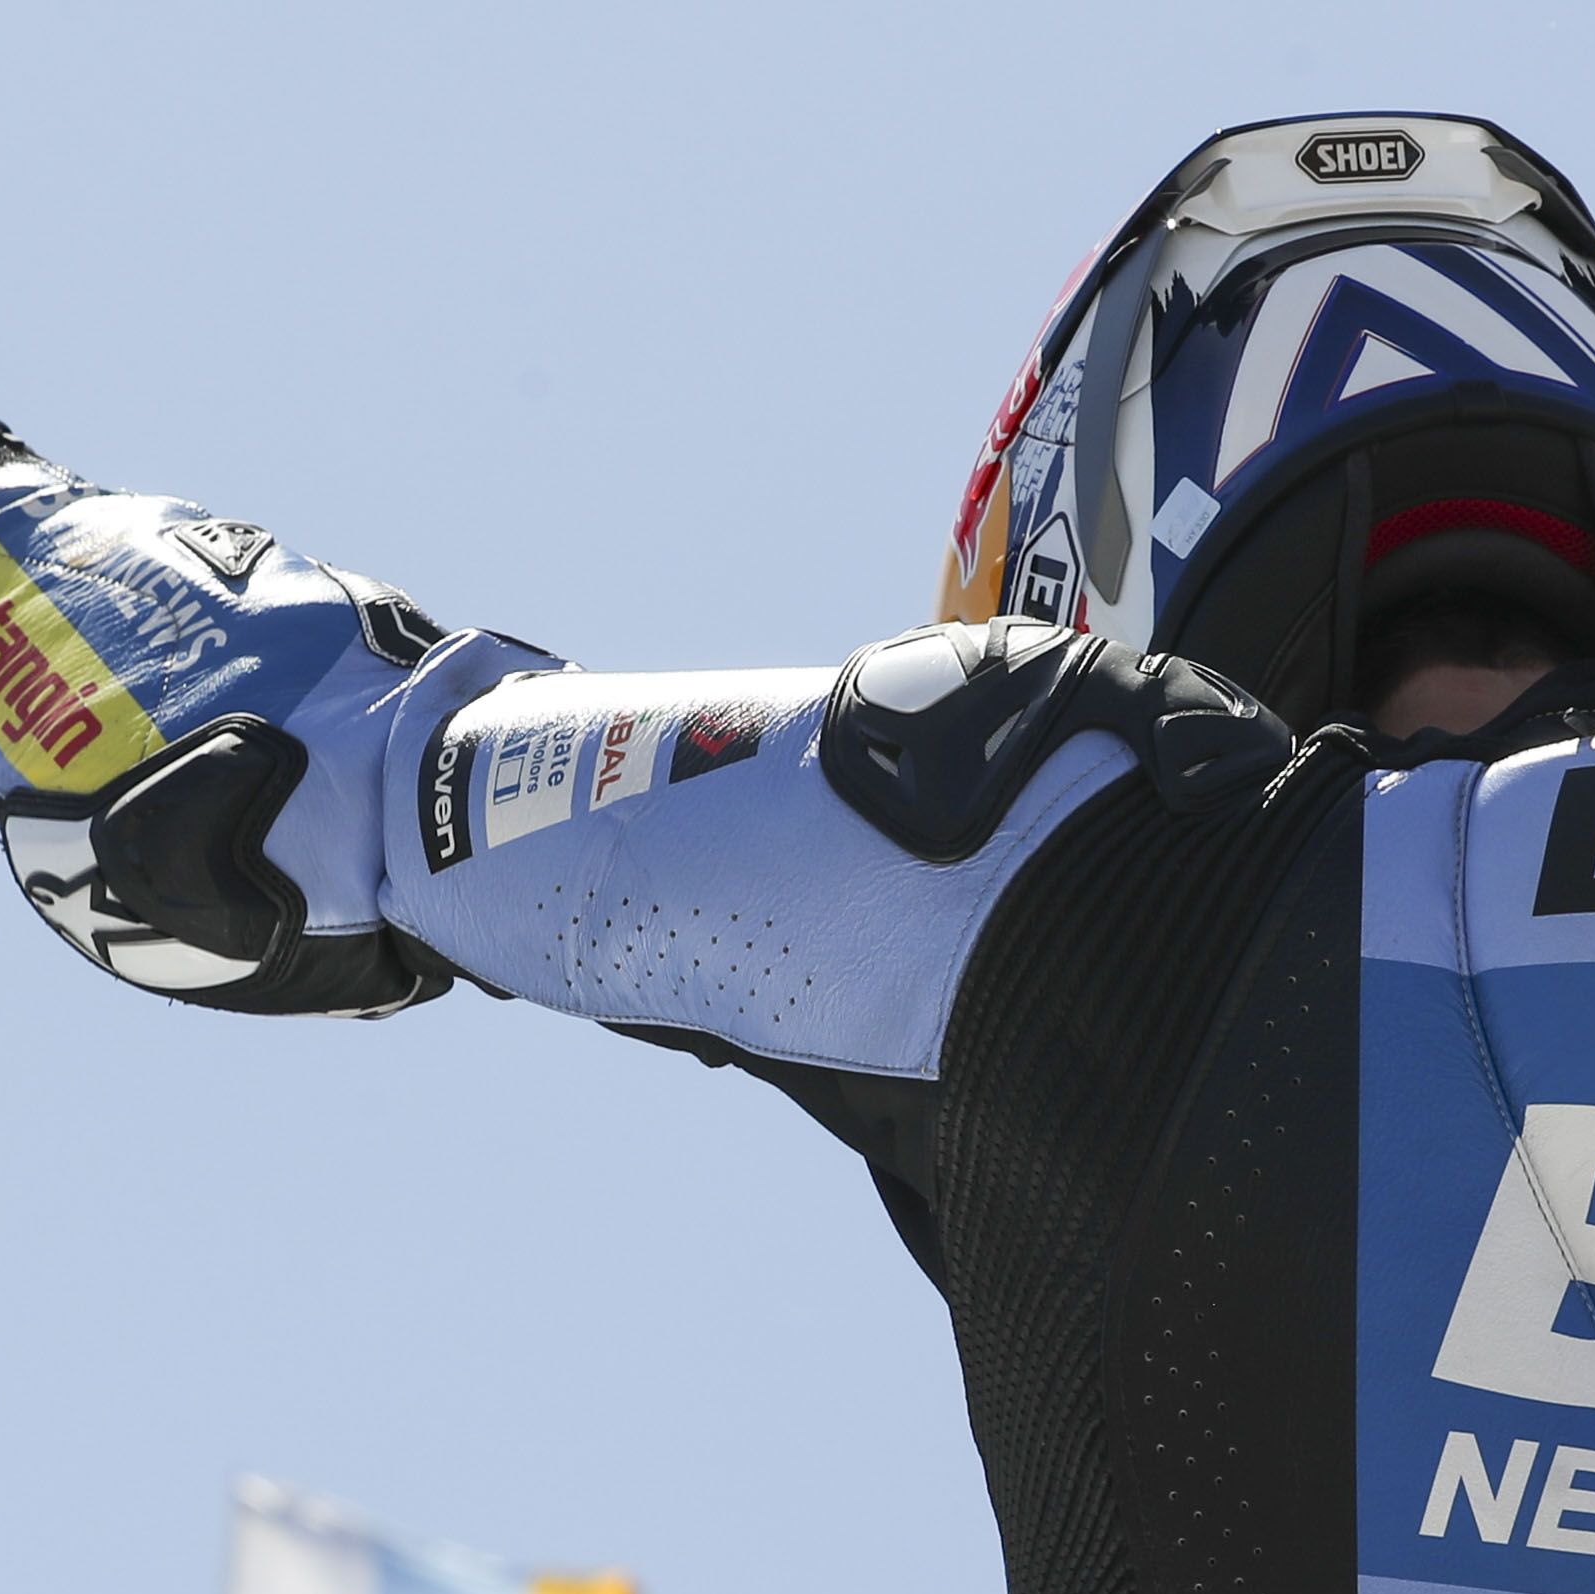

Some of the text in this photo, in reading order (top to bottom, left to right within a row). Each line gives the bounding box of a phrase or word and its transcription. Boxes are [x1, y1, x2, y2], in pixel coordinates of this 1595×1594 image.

[1316, 140, 1407, 173] SHOEI
[595, 714, 633, 802] BAL
[433, 745, 459, 860] oven
